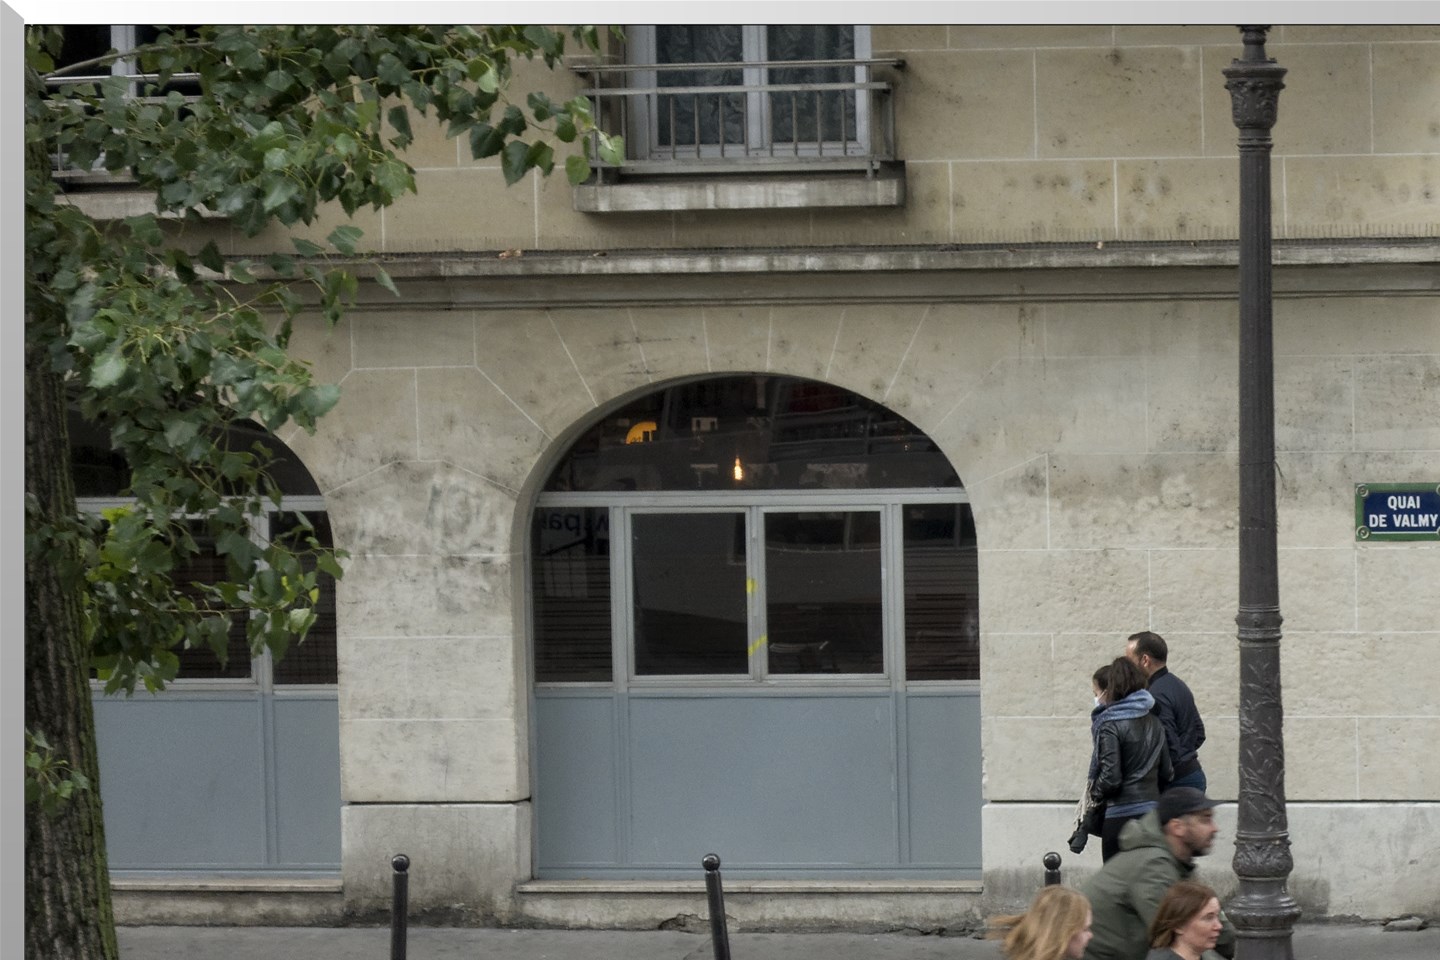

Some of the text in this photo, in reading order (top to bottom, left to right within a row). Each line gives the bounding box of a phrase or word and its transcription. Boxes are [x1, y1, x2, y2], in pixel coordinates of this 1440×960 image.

[1387, 495, 1421, 511] QUAI
[1368, 513, 1439, 528] DE VALMY
